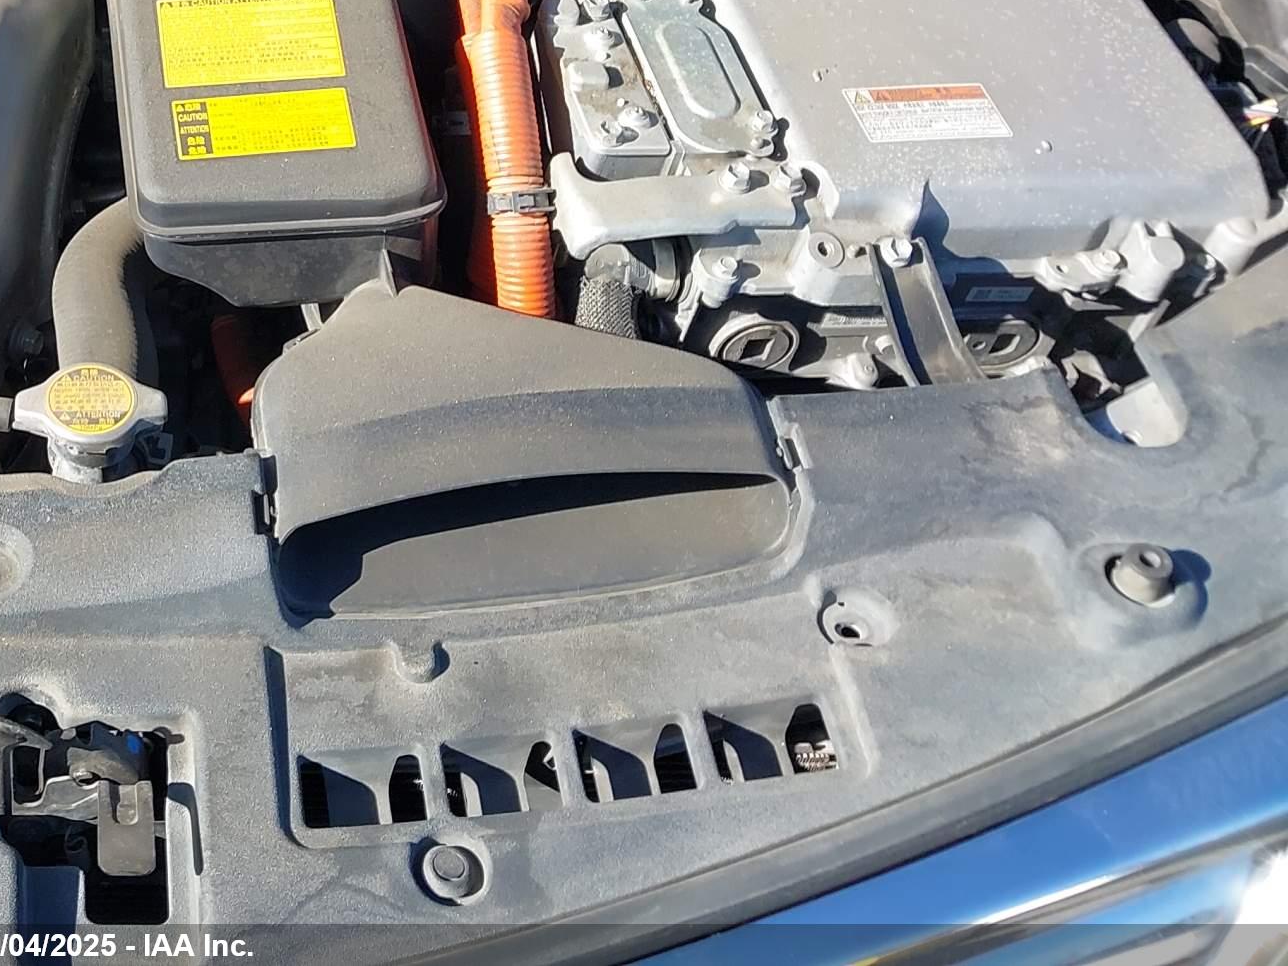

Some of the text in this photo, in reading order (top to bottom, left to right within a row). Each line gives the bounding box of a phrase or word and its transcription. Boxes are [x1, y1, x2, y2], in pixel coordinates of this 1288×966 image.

[178, 112, 209, 123] CAUTION
[180, 124, 210, 135] ATTENTION
[73, 374, 115, 382] CAUTION
[76, 410, 121, 419] ATTENTION
